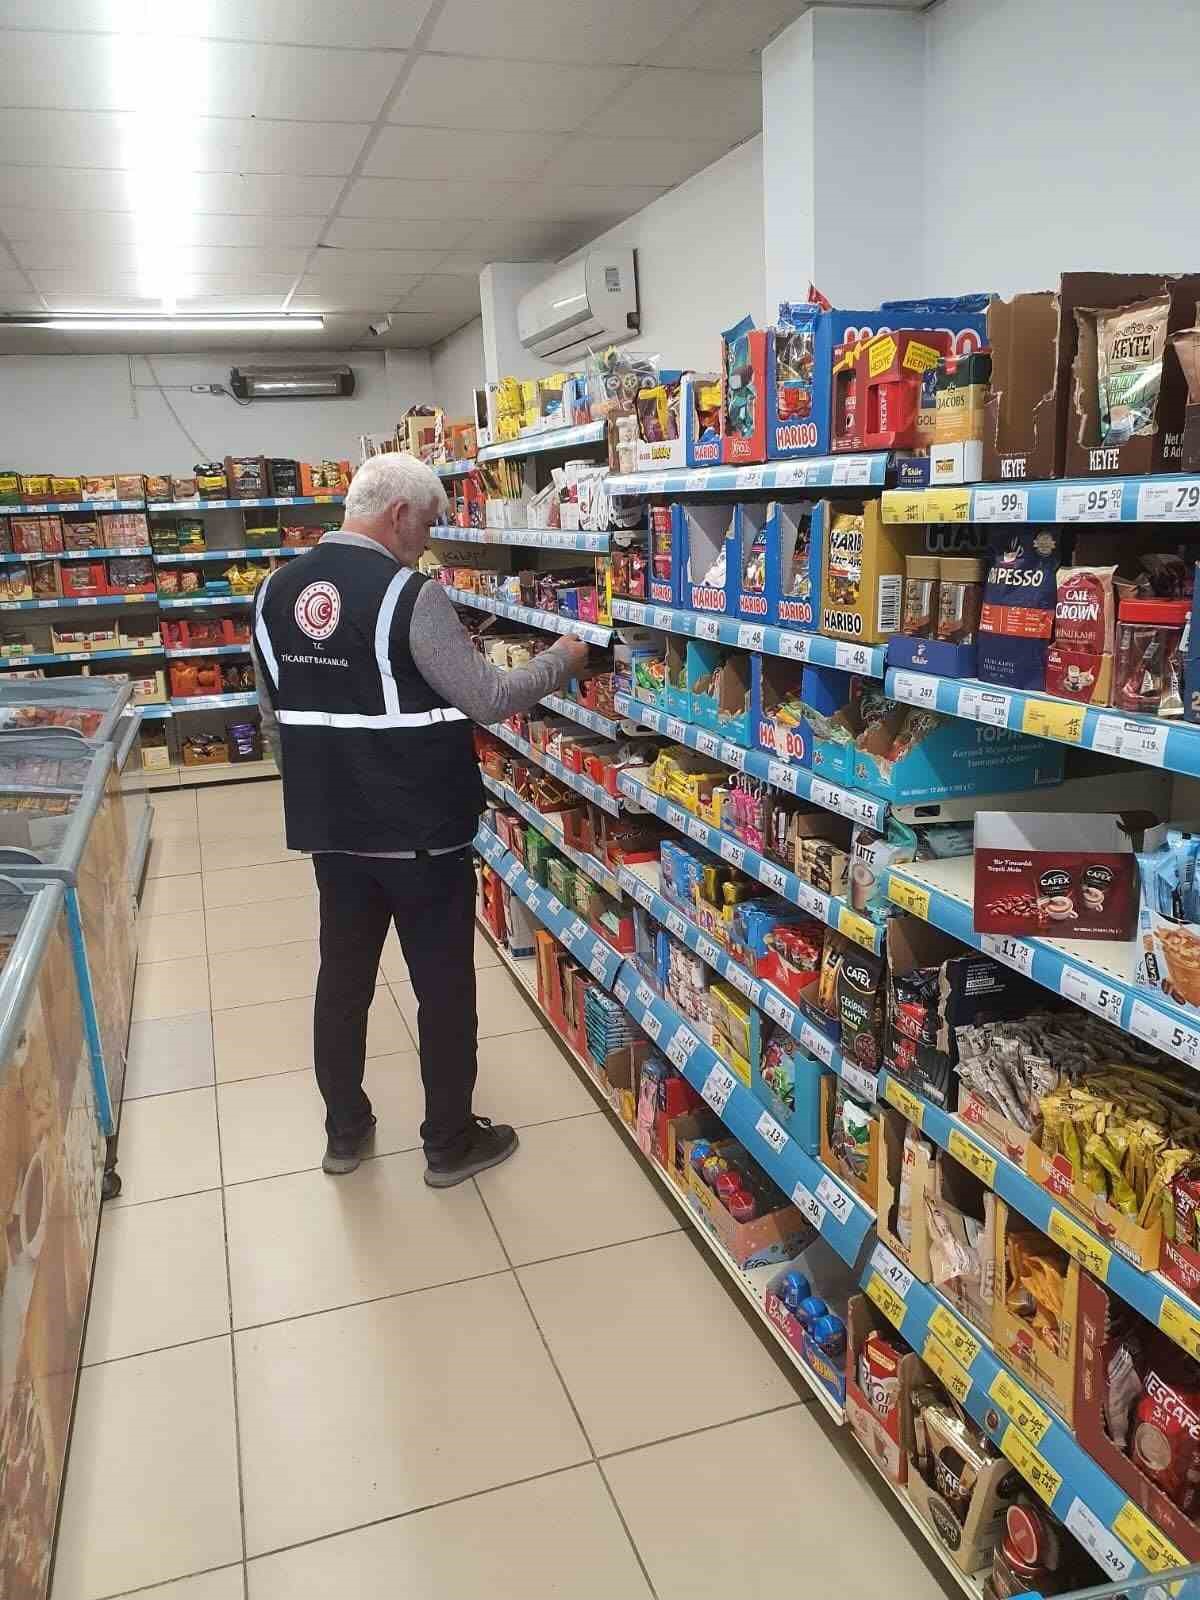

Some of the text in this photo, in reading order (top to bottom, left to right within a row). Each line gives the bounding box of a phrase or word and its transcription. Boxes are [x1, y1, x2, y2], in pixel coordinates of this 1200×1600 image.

[1112, 335, 1151, 360] KEYFE
[937, 396, 965, 409] JACOBS
[917, 414, 936, 426] GOL
[776, 423, 817, 451] HARIBO
[694, 445, 719, 461] HARIBO
[1089, 448, 1120, 471] KEYFE
[1001, 459, 1027, 478] KEYFE
[1001, 493, 1018, 512] 99
[692, 587, 726, 612] HARIBO
[740, 594, 768, 615] HARIBO
[778, 600, 813, 623] HARIBO
[1056, 603, 1099, 621] CROWN
[823, 609, 862, 635] HARIBO
[751, 631, 761, 643] 48
[794, 640, 805, 652] 48
[281, 654, 313, 664] TİCARET
[853, 651, 865, 664] 48
[760, 721, 804, 759] HABO
[783, 771, 791, 783] 24
[829, 792, 839, 806] 15
[862, 804, 873, 818] 15
[856, 844, 876, 865] LATTE
[773, 875, 783, 887] 24
[1040, 876, 1070, 887] CAFEX
[1086, 870, 1112, 882] CAFEX
[814, 898, 824, 913] 30
[846, 965, 871, 989] CAFEX
[723, 1078, 733, 1089] 19
[808, 1200, 819, 1216] 30
[833, 1195, 846, 1209] 27
[1105, 1549, 1125, 1571] 247
